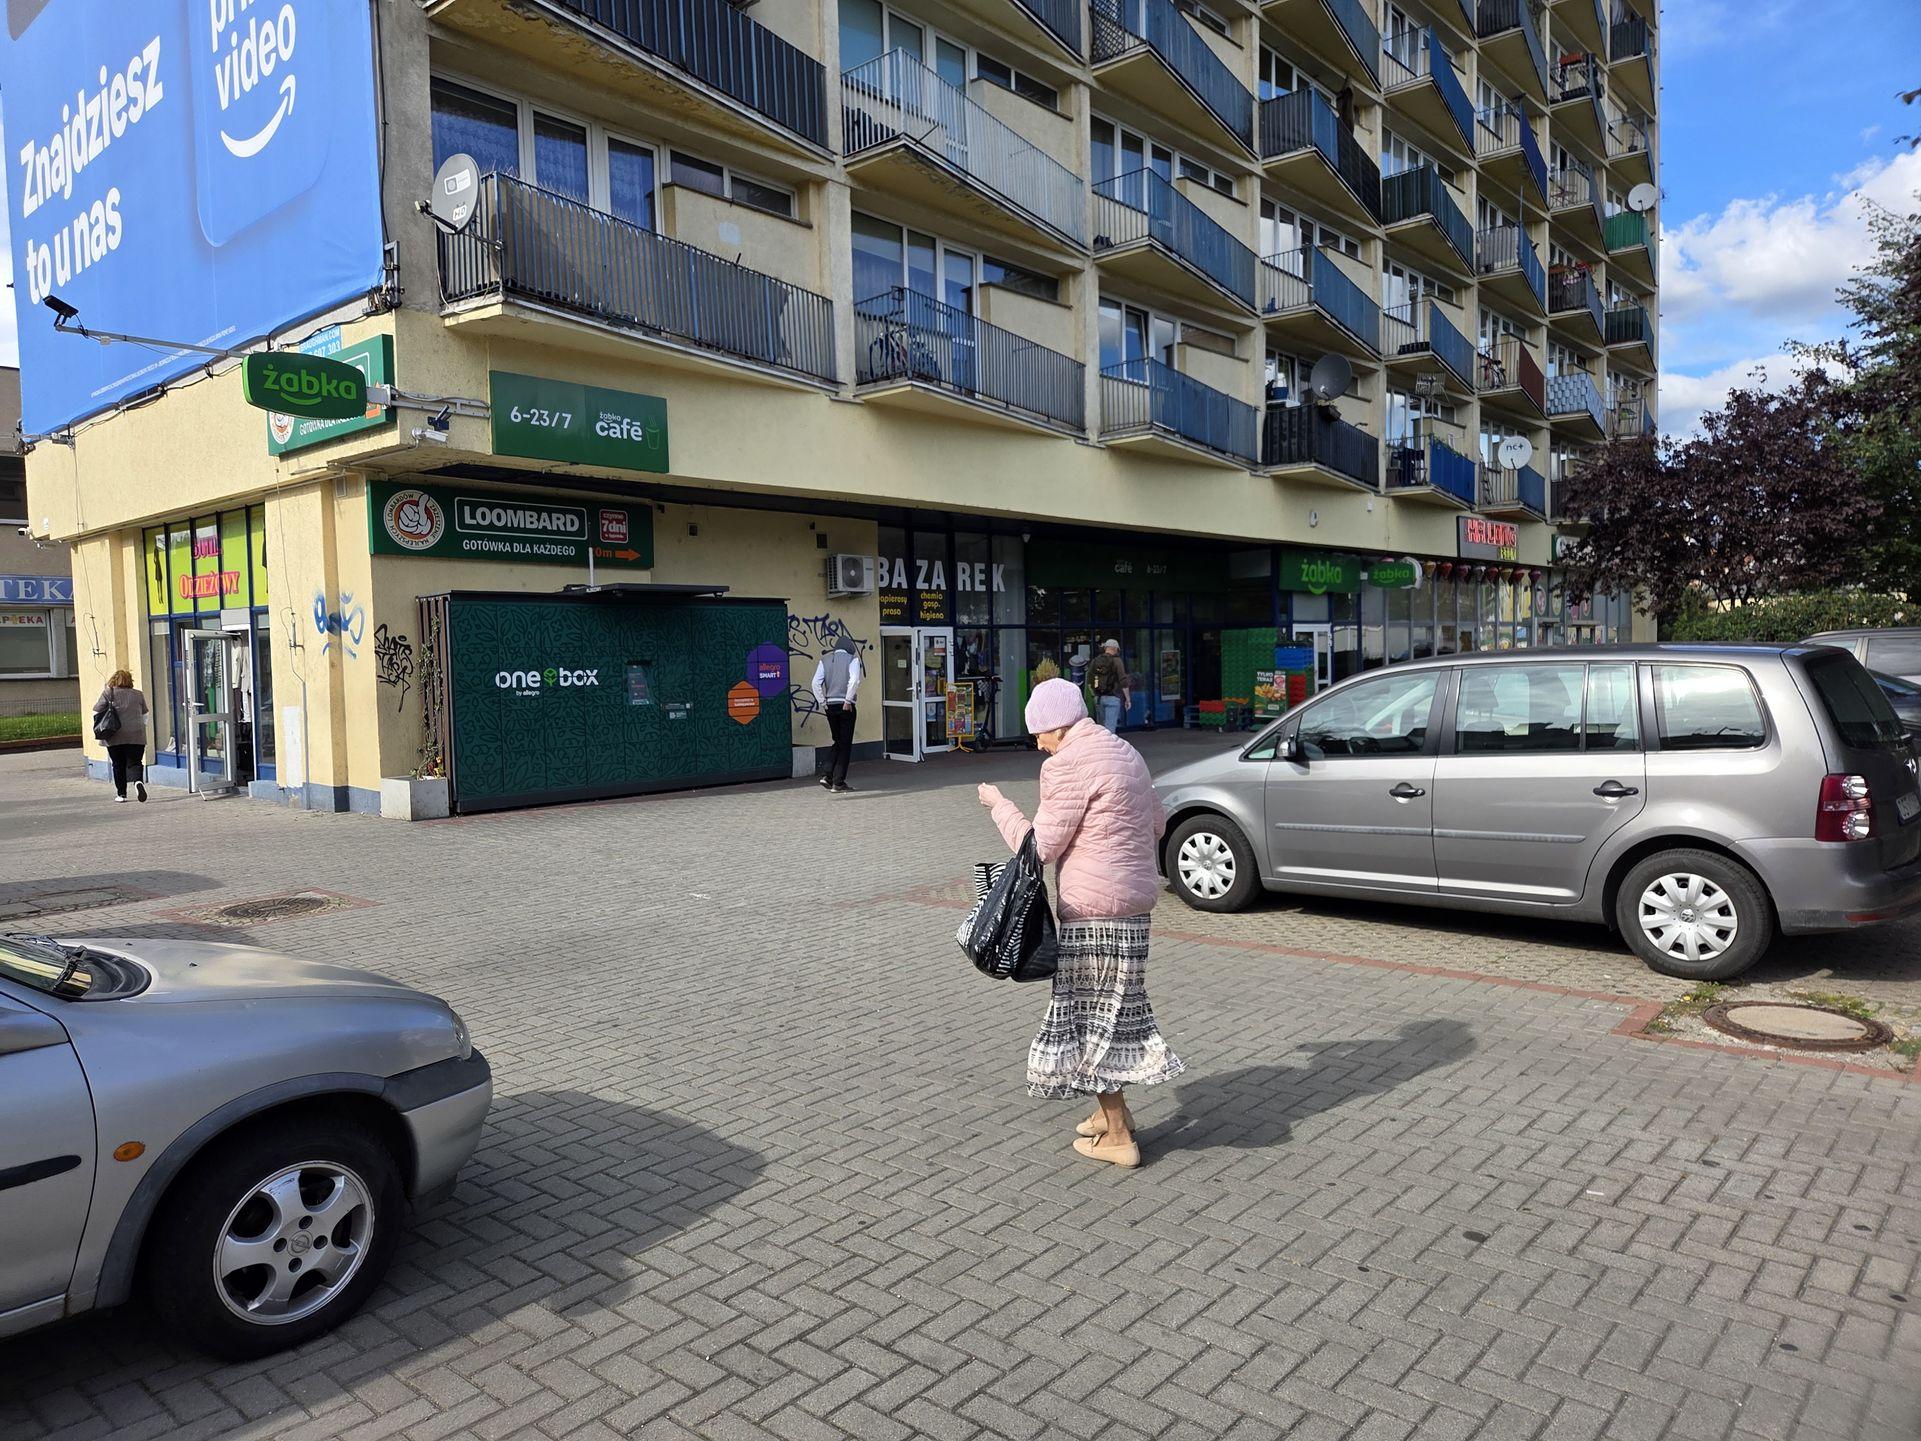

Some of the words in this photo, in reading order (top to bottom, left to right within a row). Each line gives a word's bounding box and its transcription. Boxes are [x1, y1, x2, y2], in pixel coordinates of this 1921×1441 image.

[215, 4, 296, 111] video
[20, 35, 164, 218] Znajdziesz
[26, 239, 52, 305] to
[54, 229, 72, 288] u
[73, 187, 123, 275] nas
[263, 363, 357, 400] żabka
[510, 406, 572, 428] 6-23/7
[1506, 443, 1524, 451] nc+
[464, 506, 579, 532] LOOMBARD
[463, 538, 511, 552] GOTÓWKA
[513, 543, 532, 554] DLA
[533, 543, 576, 556] KAŻDEGO
[1301, 559, 1342, 583] żabka
[1373, 568, 1410, 580] żabka
[0, 580, 74, 600] TEK
[879, 594, 908, 605] apierosy
[495, 671, 541, 688] one
[559, 667, 599, 687] box
